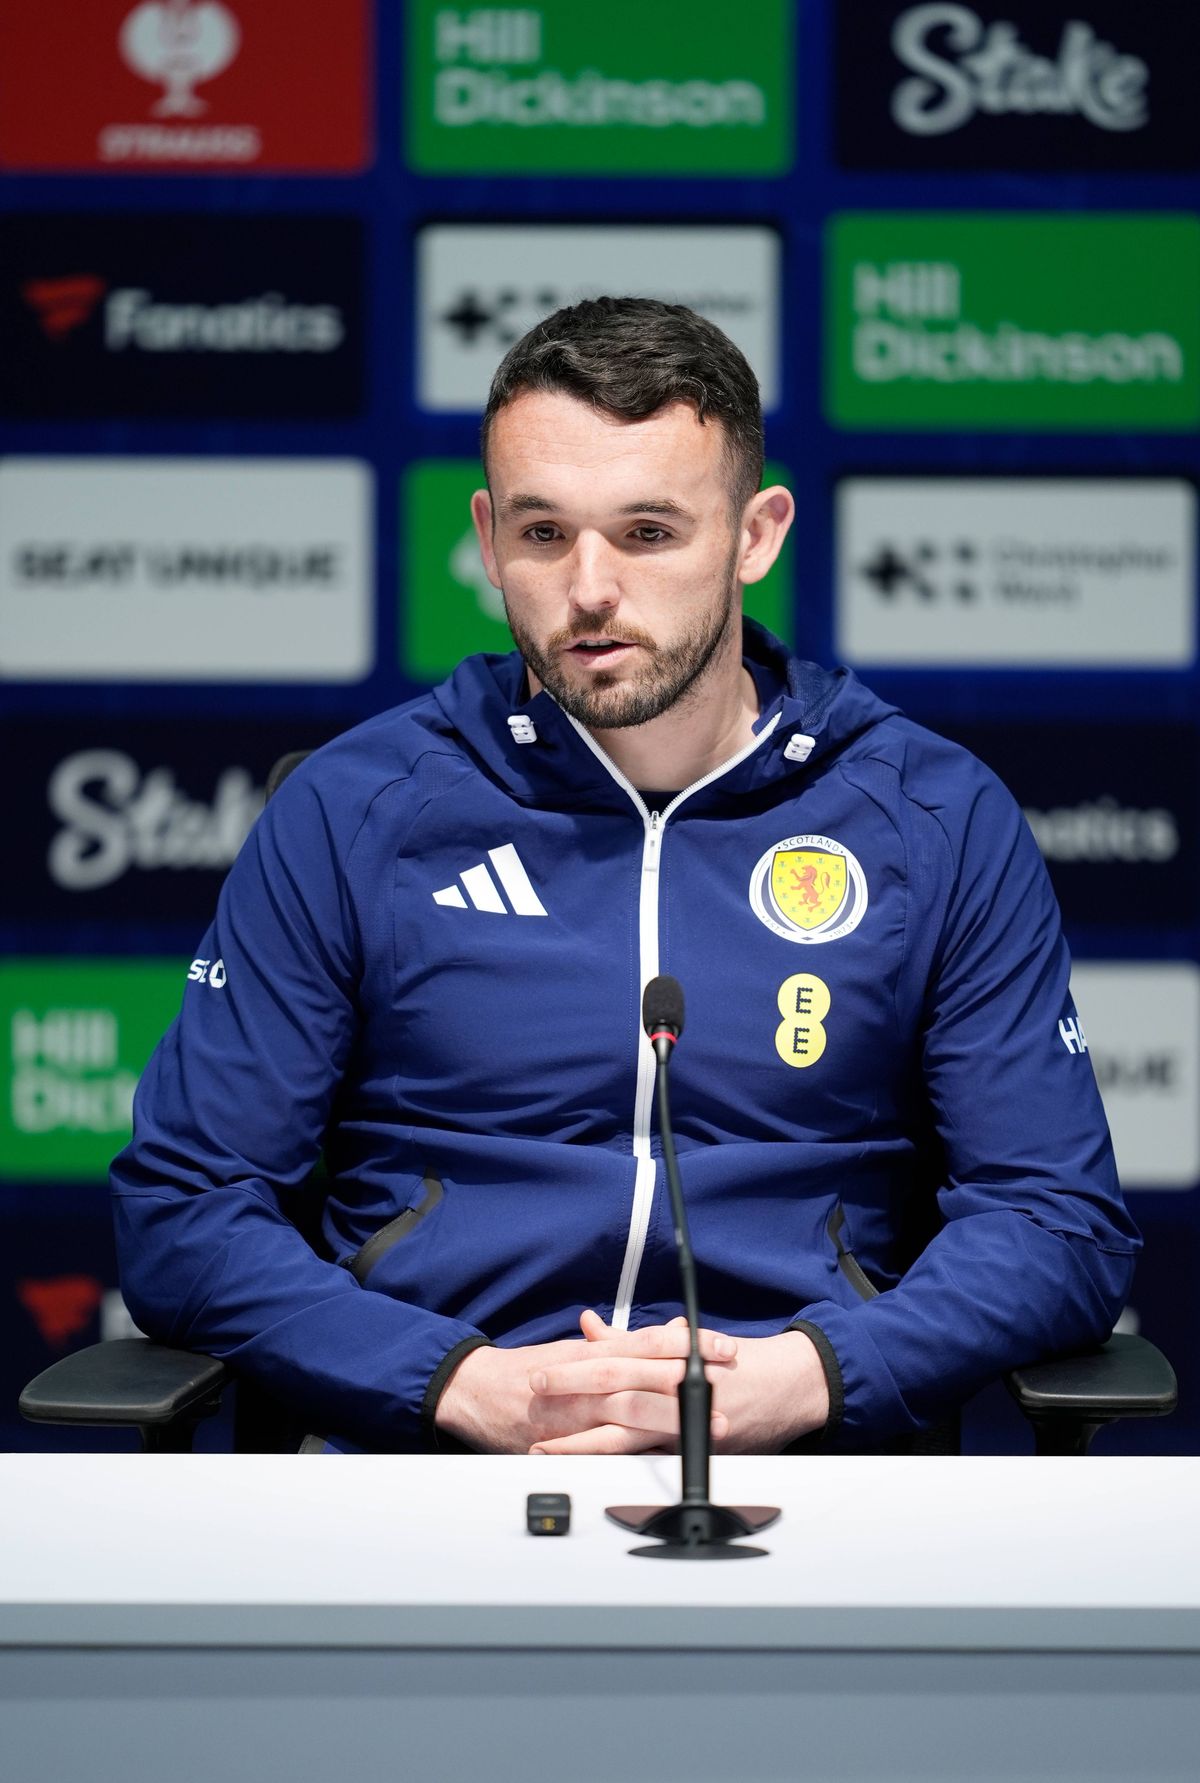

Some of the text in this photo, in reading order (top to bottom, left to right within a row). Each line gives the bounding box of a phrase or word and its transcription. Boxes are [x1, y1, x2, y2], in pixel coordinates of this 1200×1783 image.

[437, 11, 540, 62] Hill
[892, 5, 1149, 134] Stake
[436, 72, 765, 125] Dickinson
[854, 264, 960, 317] Hill
[105, 290, 343, 350] Fanatics
[854, 324, 1182, 381] Dickinson
[50, 750, 266, 889] Stak
[782, 836, 841, 853] SCOTLAND
[13, 1010, 118, 1066] Hill
